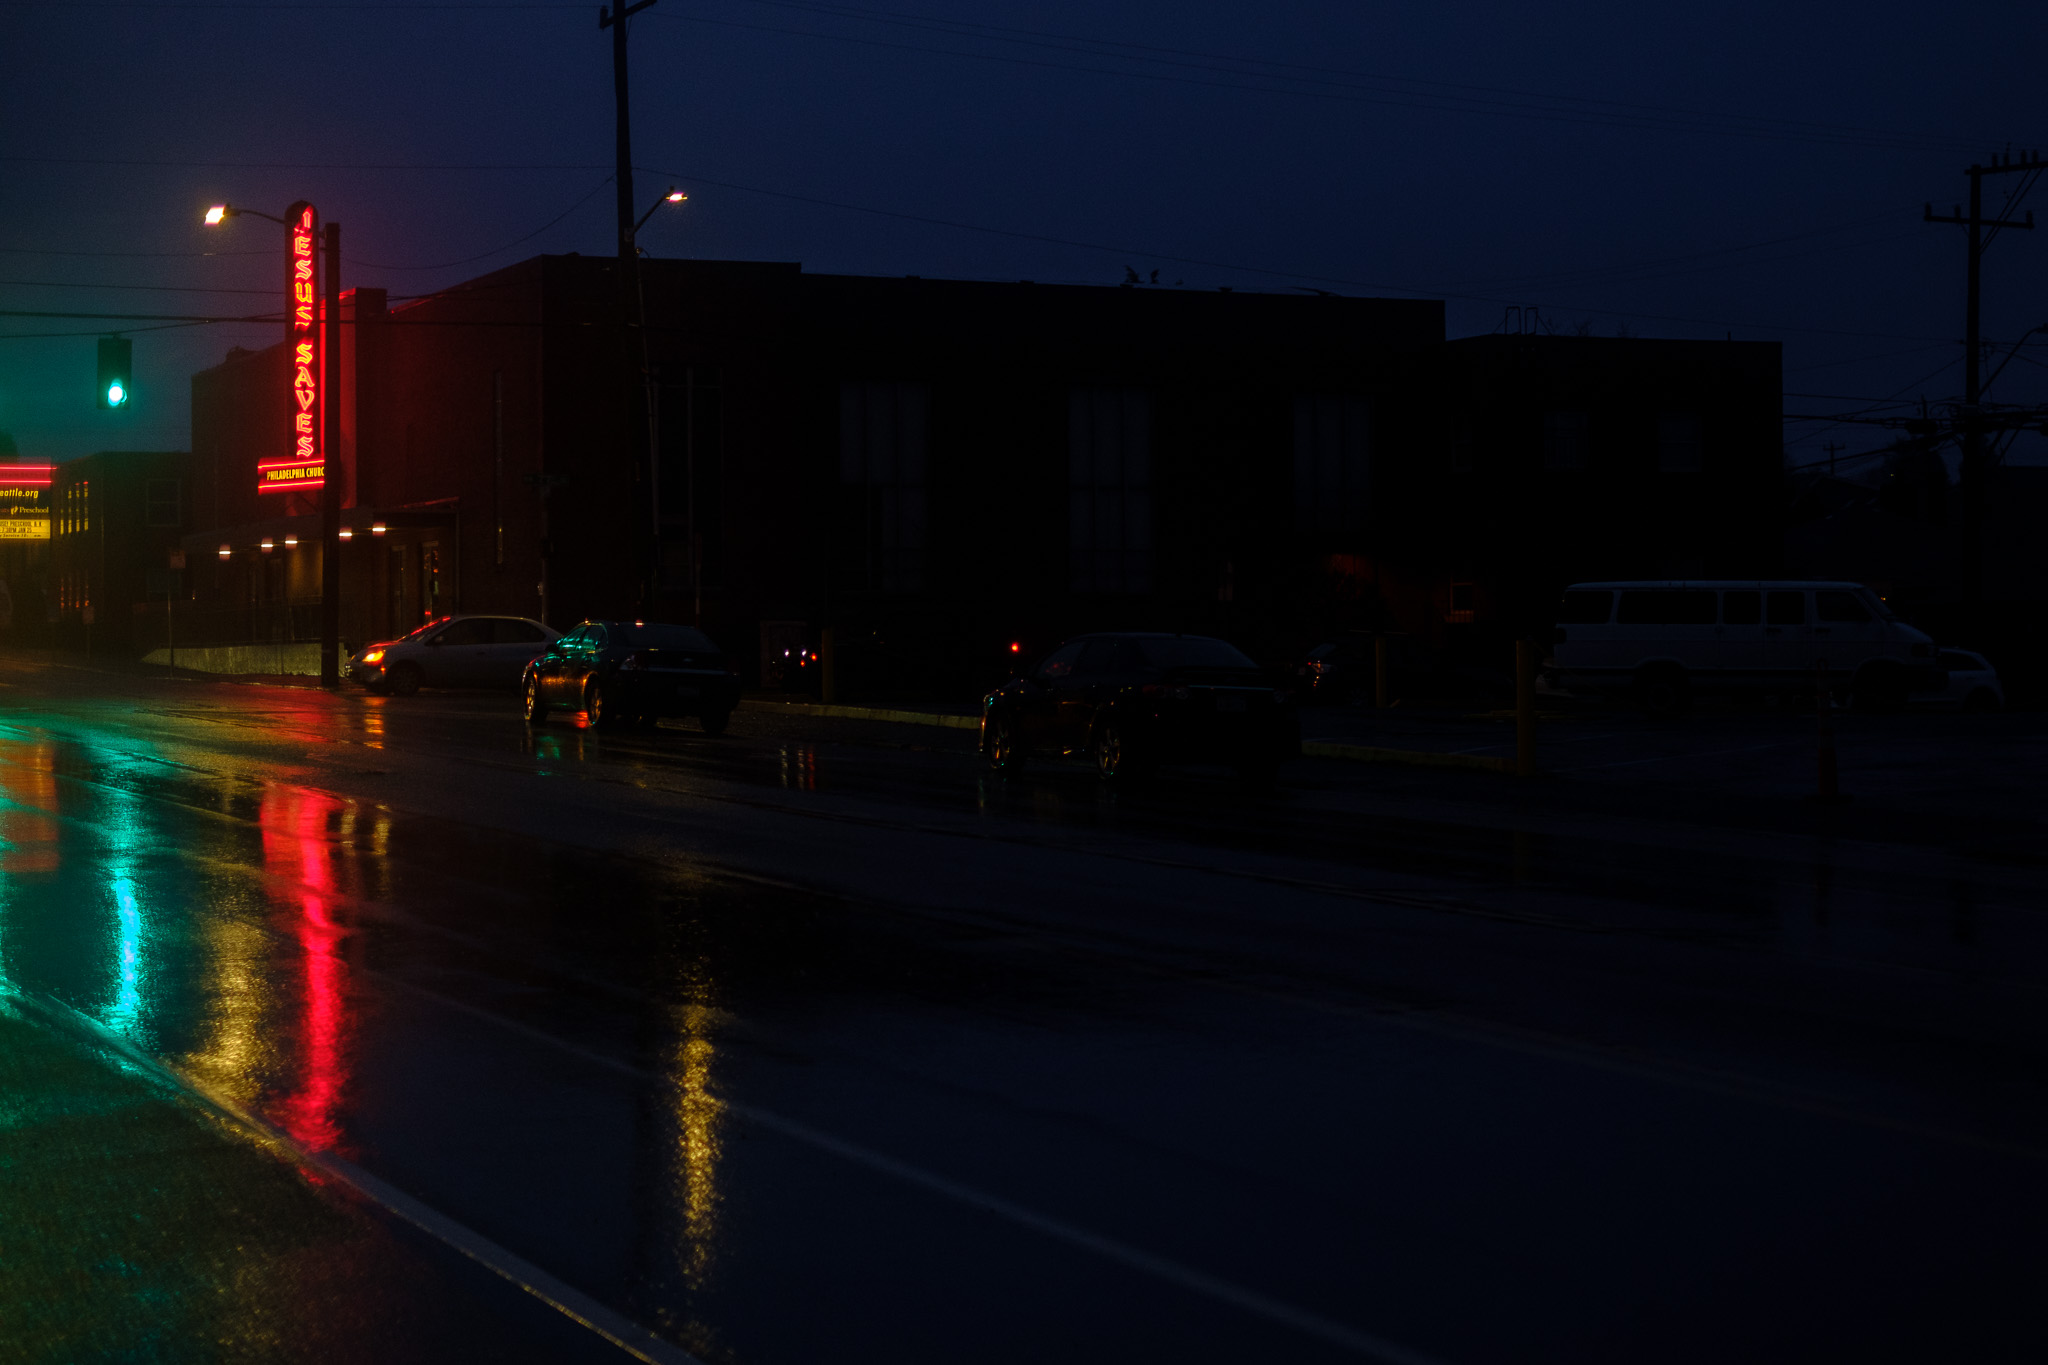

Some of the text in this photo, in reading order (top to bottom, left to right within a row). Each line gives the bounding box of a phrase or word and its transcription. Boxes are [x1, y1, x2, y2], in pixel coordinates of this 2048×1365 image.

[294, 210, 315, 459] JESUS SAVES
[266, 468, 306, 481] PHILADELPHIA
